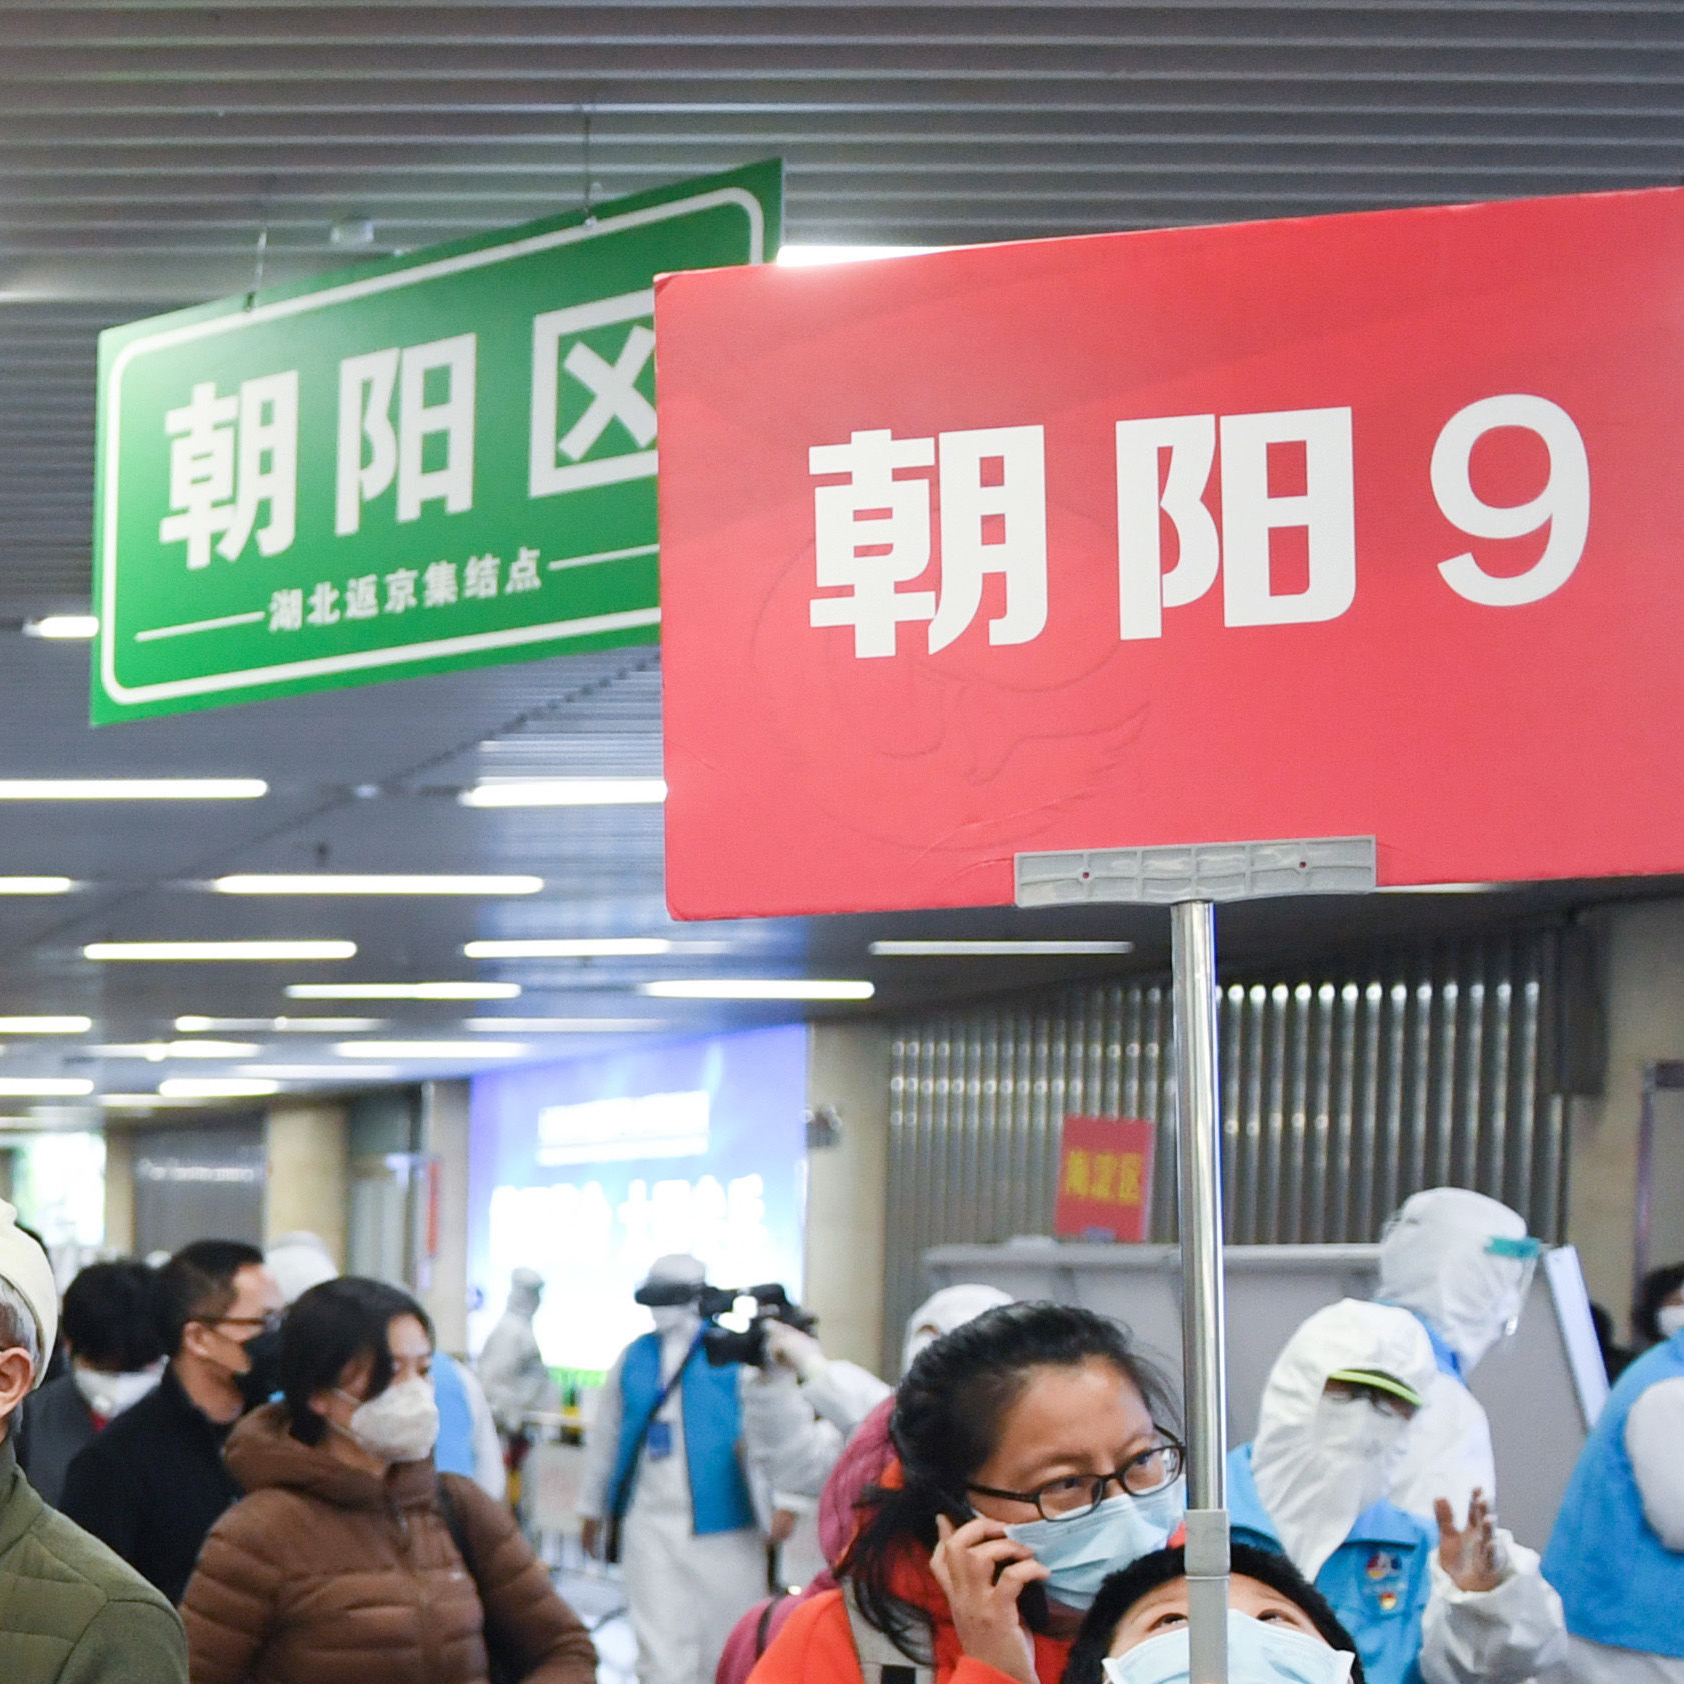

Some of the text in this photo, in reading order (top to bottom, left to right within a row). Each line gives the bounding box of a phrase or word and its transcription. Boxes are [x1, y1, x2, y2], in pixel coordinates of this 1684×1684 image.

[158, 289, 658, 570] 朝阳区
[267, 545, 541, 632] 湖北返京集结点
